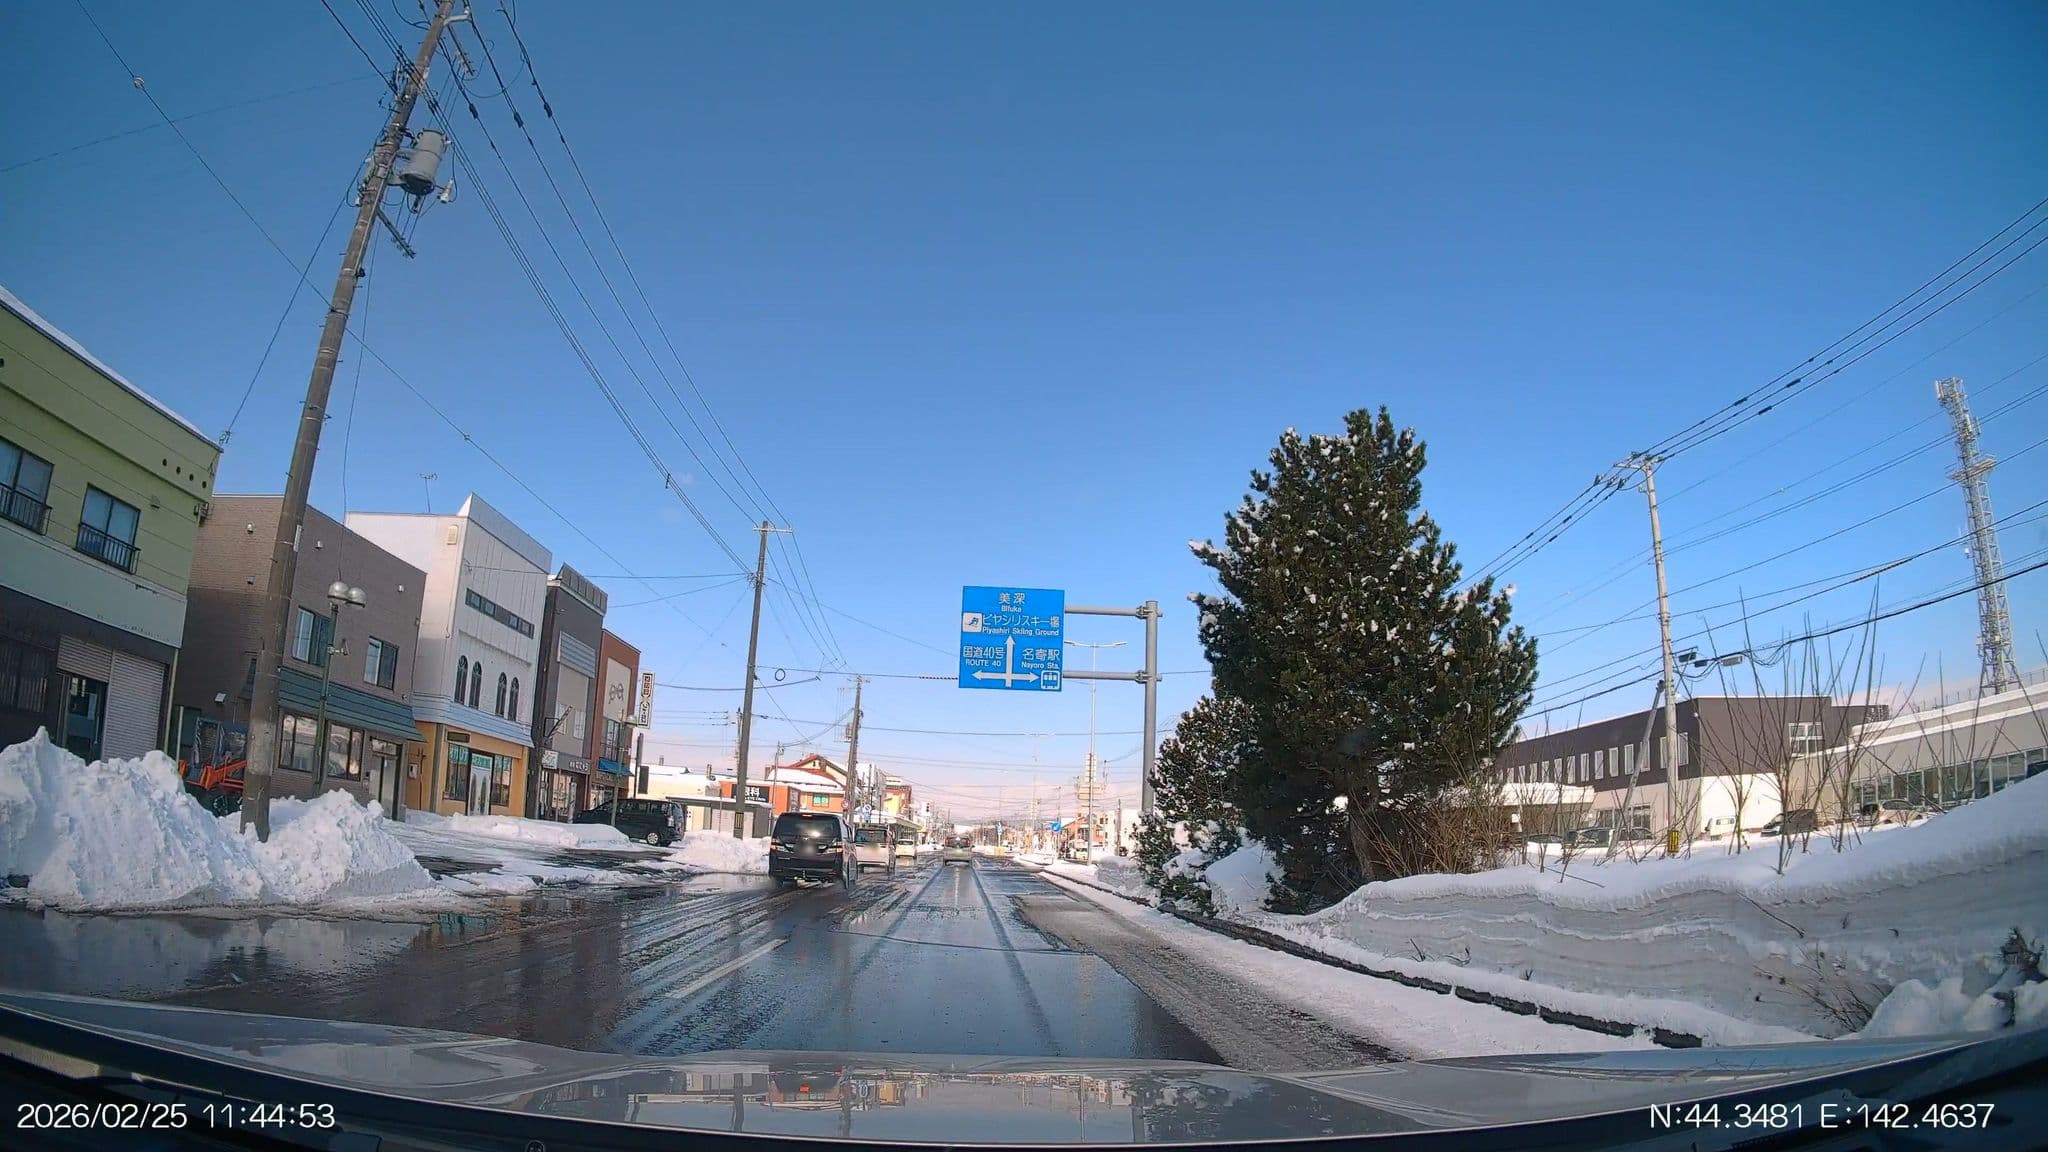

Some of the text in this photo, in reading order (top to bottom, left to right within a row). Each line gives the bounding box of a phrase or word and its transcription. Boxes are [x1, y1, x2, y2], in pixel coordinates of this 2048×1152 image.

[999, 592, 1026, 604] 美深
[982, 613, 1060, 628] ピヤシリスキー場
[982, 626, 1010, 634] Piyashiri
[963, 645, 1005, 659] 国道40号
[1022, 648, 1060, 661] 名寄駅
